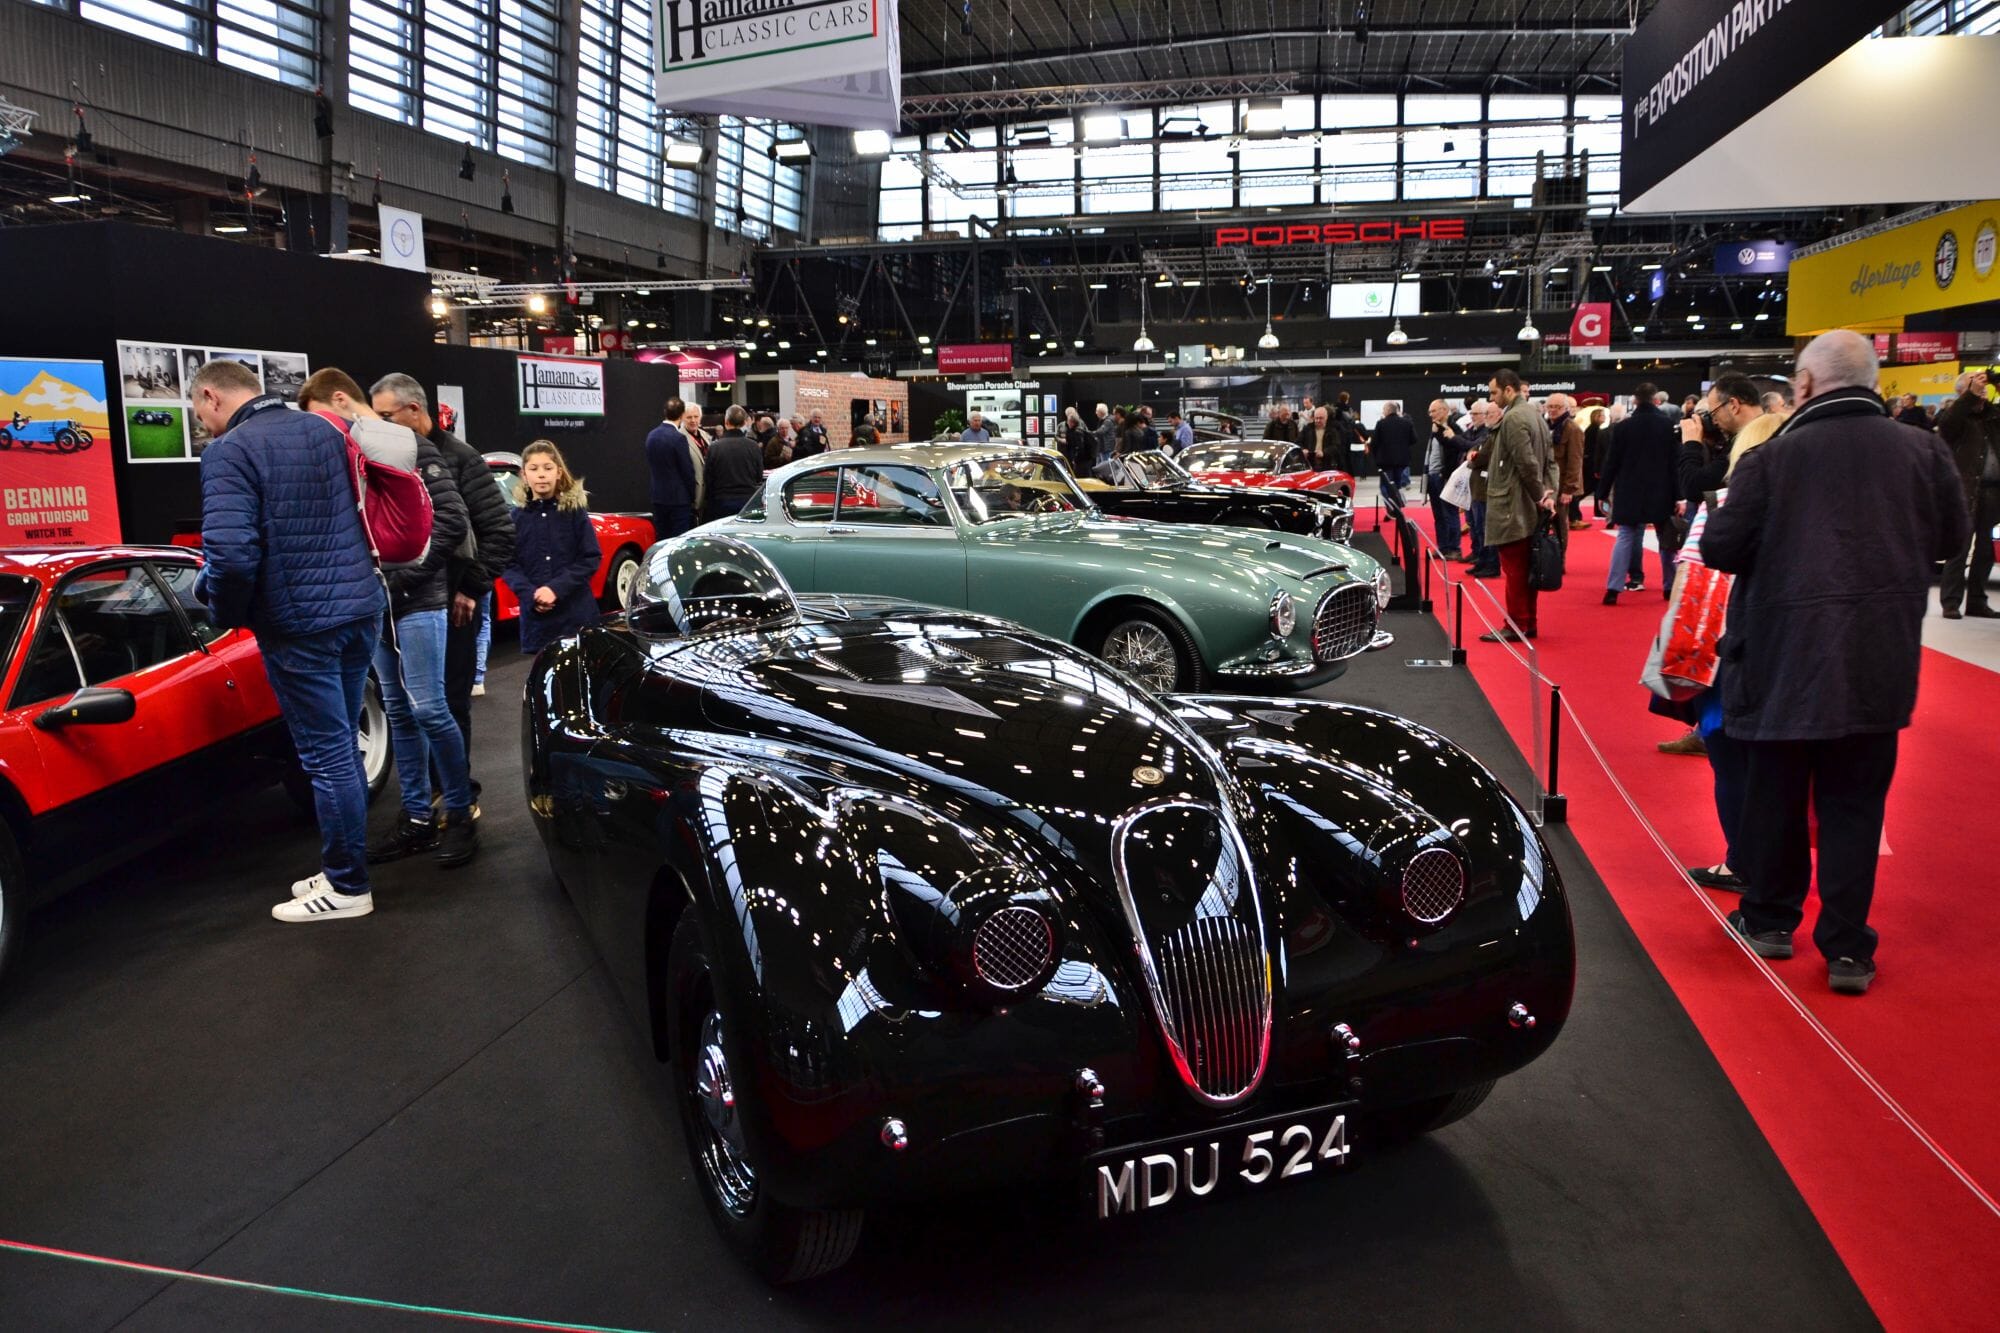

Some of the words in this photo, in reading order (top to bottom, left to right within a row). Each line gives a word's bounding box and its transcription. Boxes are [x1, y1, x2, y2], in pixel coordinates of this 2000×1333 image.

[705, 16, 796, 50] CLASSIC
[808, 5, 868, 31] CARS
[1649, 14, 1729, 126] EXPOSITION
[1731, 0, 1791, 53] PAR
[1216, 220, 1465, 247] PORSCHE
[1850, 260, 1922, 296] Heritage
[1579, 314, 1601, 337] G
[521, 362, 576, 408] Hamann
[539, 389, 577, 406] CLASSIC
[580, 391, 601, 406] CARS
[947, 382, 985, 391] Showroom
[985, 381, 1014, 390] Porsche
[1014, 380, 1040, 389] Classic
[1440, 384, 1470, 393] Porsche
[4, 485, 87, 510] BERNINA
[7, 511, 39, 526] GRAN
[40, 509, 89, 524] TURISMO
[25, 528, 55, 540] WATCH
[57, 527, 73, 538] THE
[1098, 1143, 1220, 1219] MDU
[1240, 1115, 1350, 1184] 524
